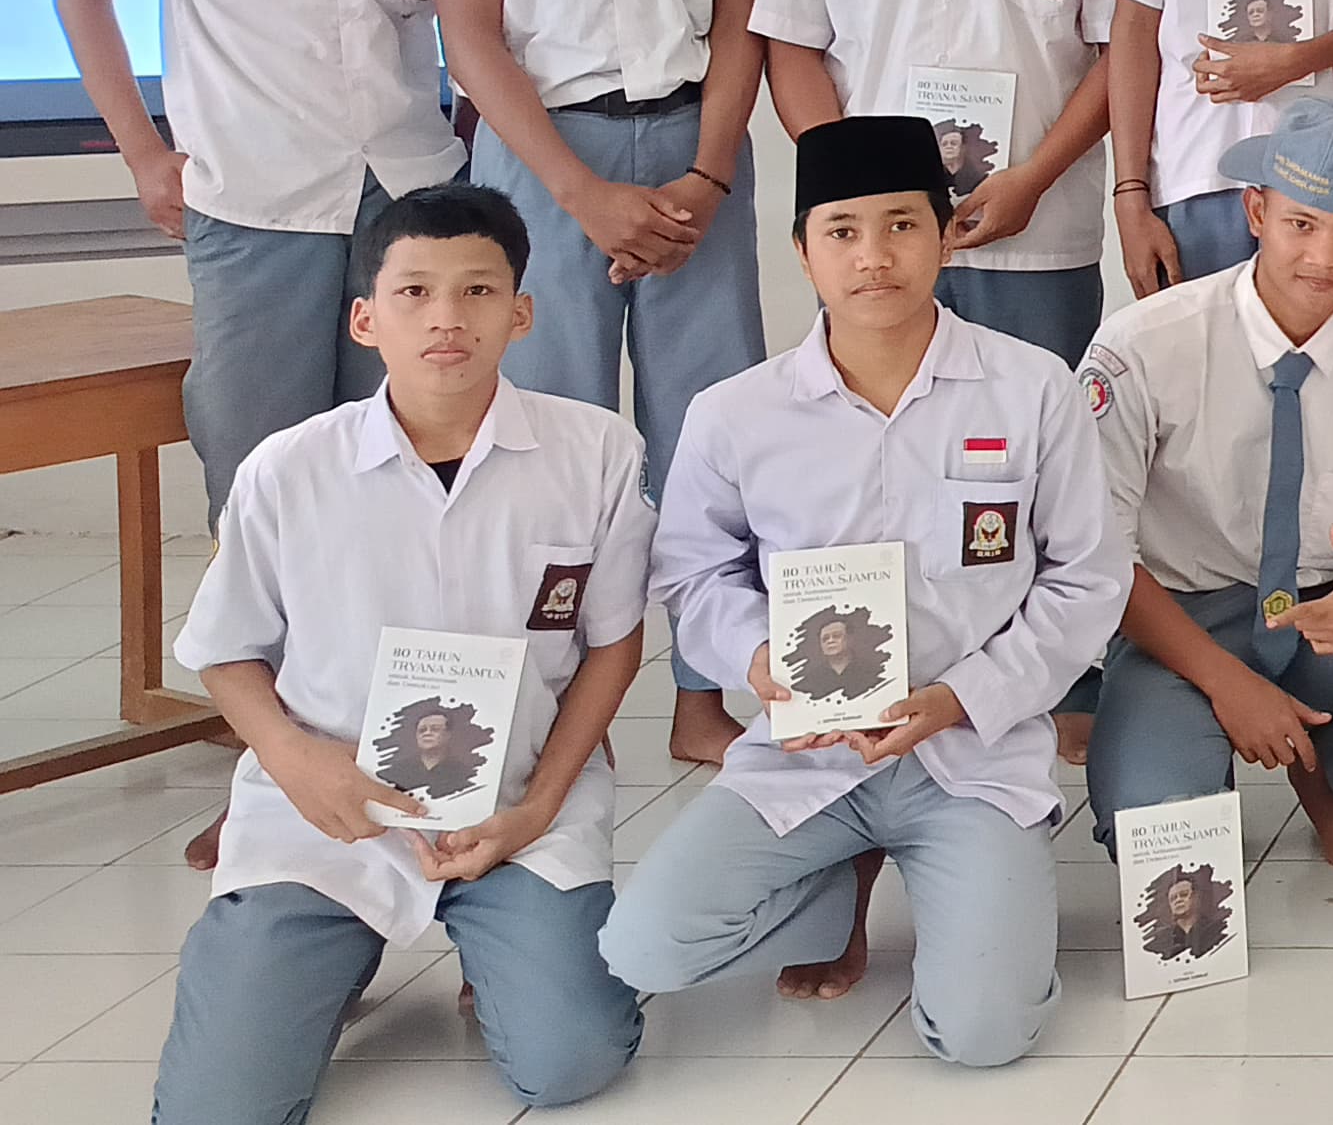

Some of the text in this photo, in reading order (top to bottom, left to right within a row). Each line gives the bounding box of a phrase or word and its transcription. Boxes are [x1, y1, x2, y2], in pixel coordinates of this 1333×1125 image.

[803, 562, 847, 576] TAHUN
[784, 576, 835, 590] TRYANA
[415, 649, 462, 663] TAHUN
[392, 660, 445, 675] TRYANA
[1152, 820, 1191, 835] TAHUN
[1133, 834, 1181, 850] TRYANA
